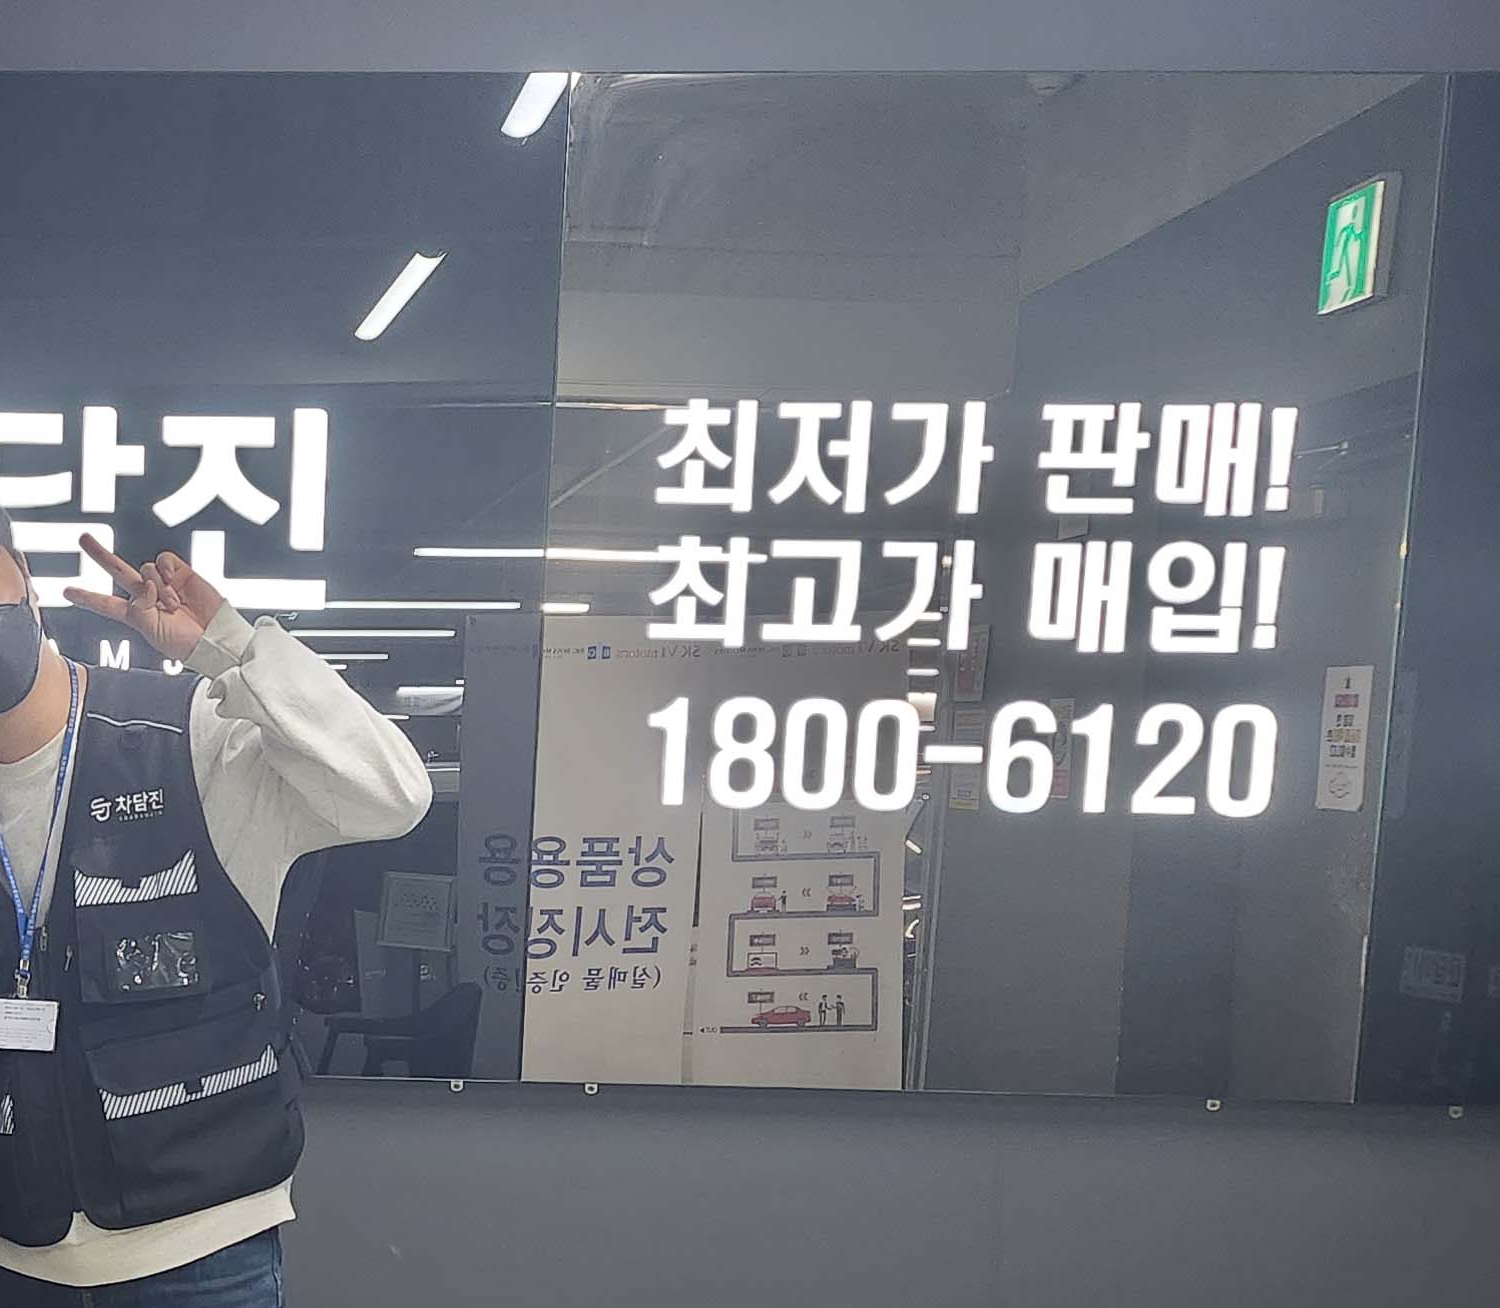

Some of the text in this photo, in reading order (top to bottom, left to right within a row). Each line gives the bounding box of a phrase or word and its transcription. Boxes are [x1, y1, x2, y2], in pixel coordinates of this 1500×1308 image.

[655, 398, 1298, 517] 최저가 판매!
[646, 536, 1286, 653] 최고가 매입!
[115, 788, 164, 814] 차담진
[647, 696, 1278, 818] 1800-6120
